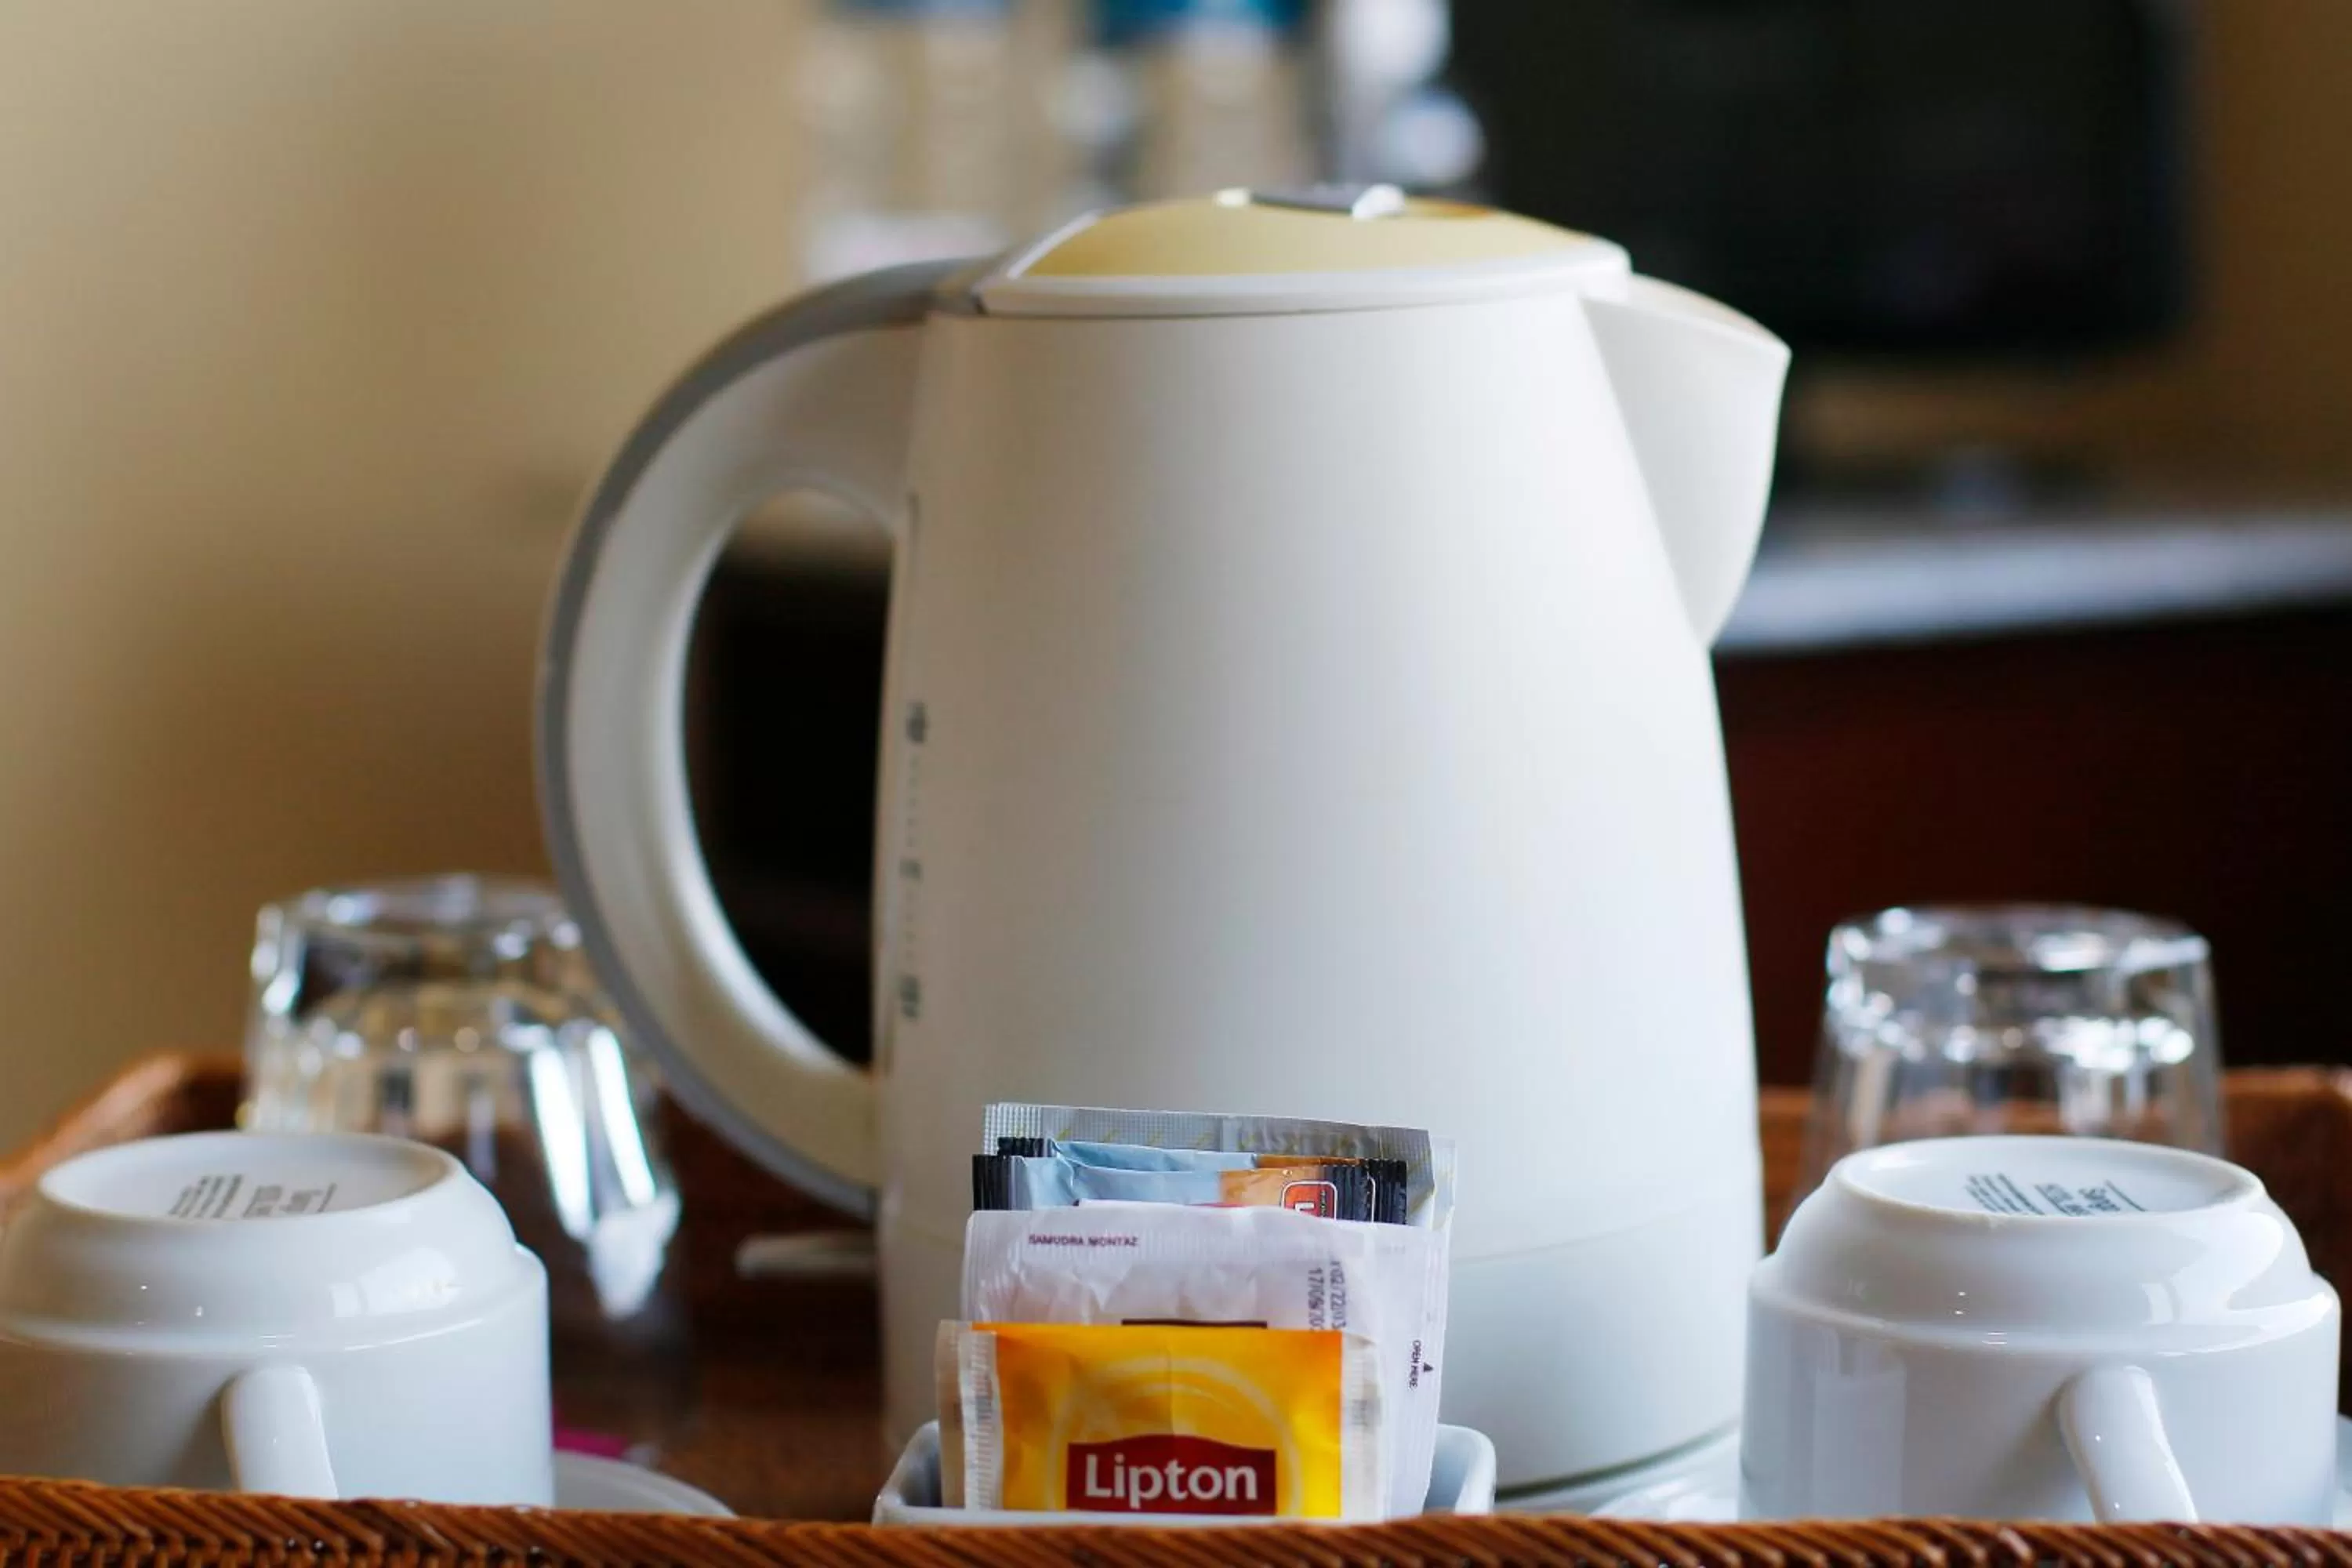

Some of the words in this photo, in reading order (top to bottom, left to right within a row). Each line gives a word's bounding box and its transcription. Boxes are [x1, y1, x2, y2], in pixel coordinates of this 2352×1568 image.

[1029, 1233, 1083, 1246] SAMUDRA
[1087, 1235, 1138, 1247] MONTAZ
[1412, 1339, 1421, 1363] OPEN
[1409, 1365, 1418, 1388] HERE
[1085, 1453, 1258, 1509] Lipton
